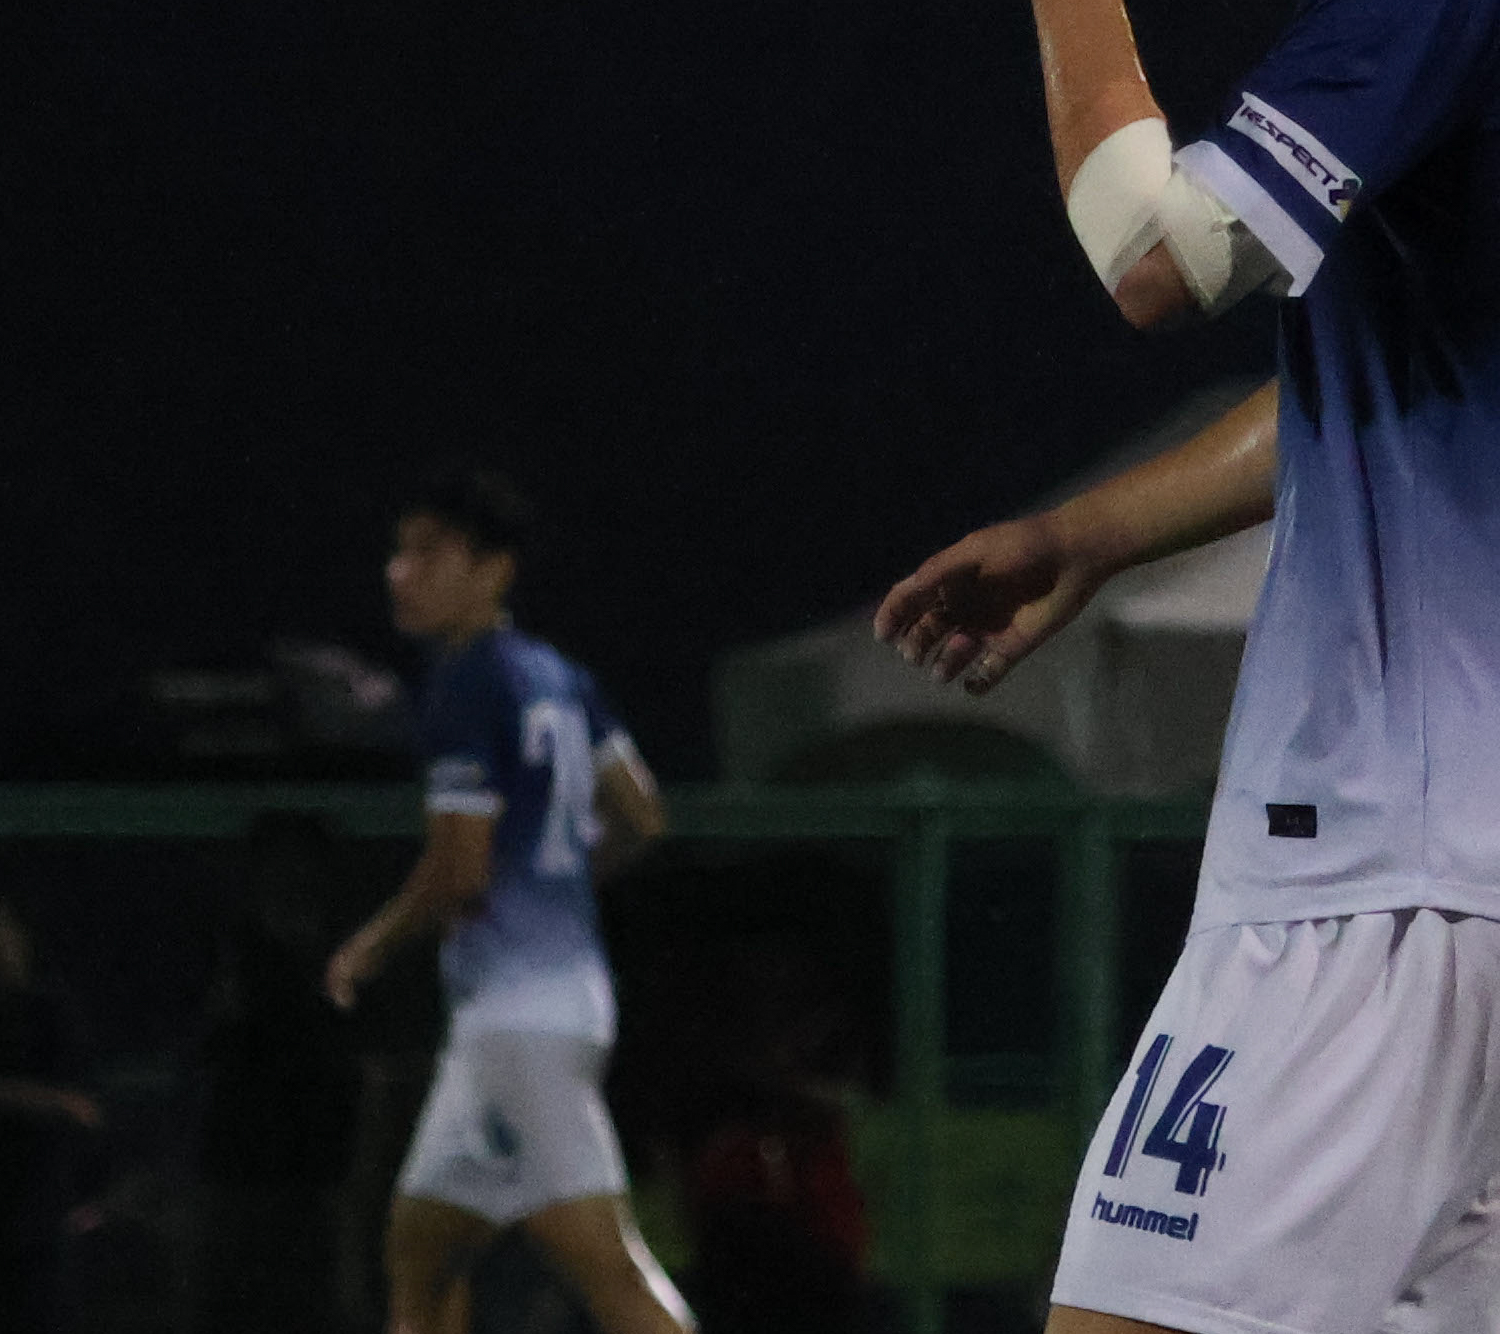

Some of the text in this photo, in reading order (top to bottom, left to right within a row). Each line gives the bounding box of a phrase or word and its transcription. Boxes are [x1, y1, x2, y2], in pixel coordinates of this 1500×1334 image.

[1240, 106, 1339, 185] RESPECT
[1103, 1034, 1235, 1197] 14
[1091, 1191, 1199, 1241] hummel
